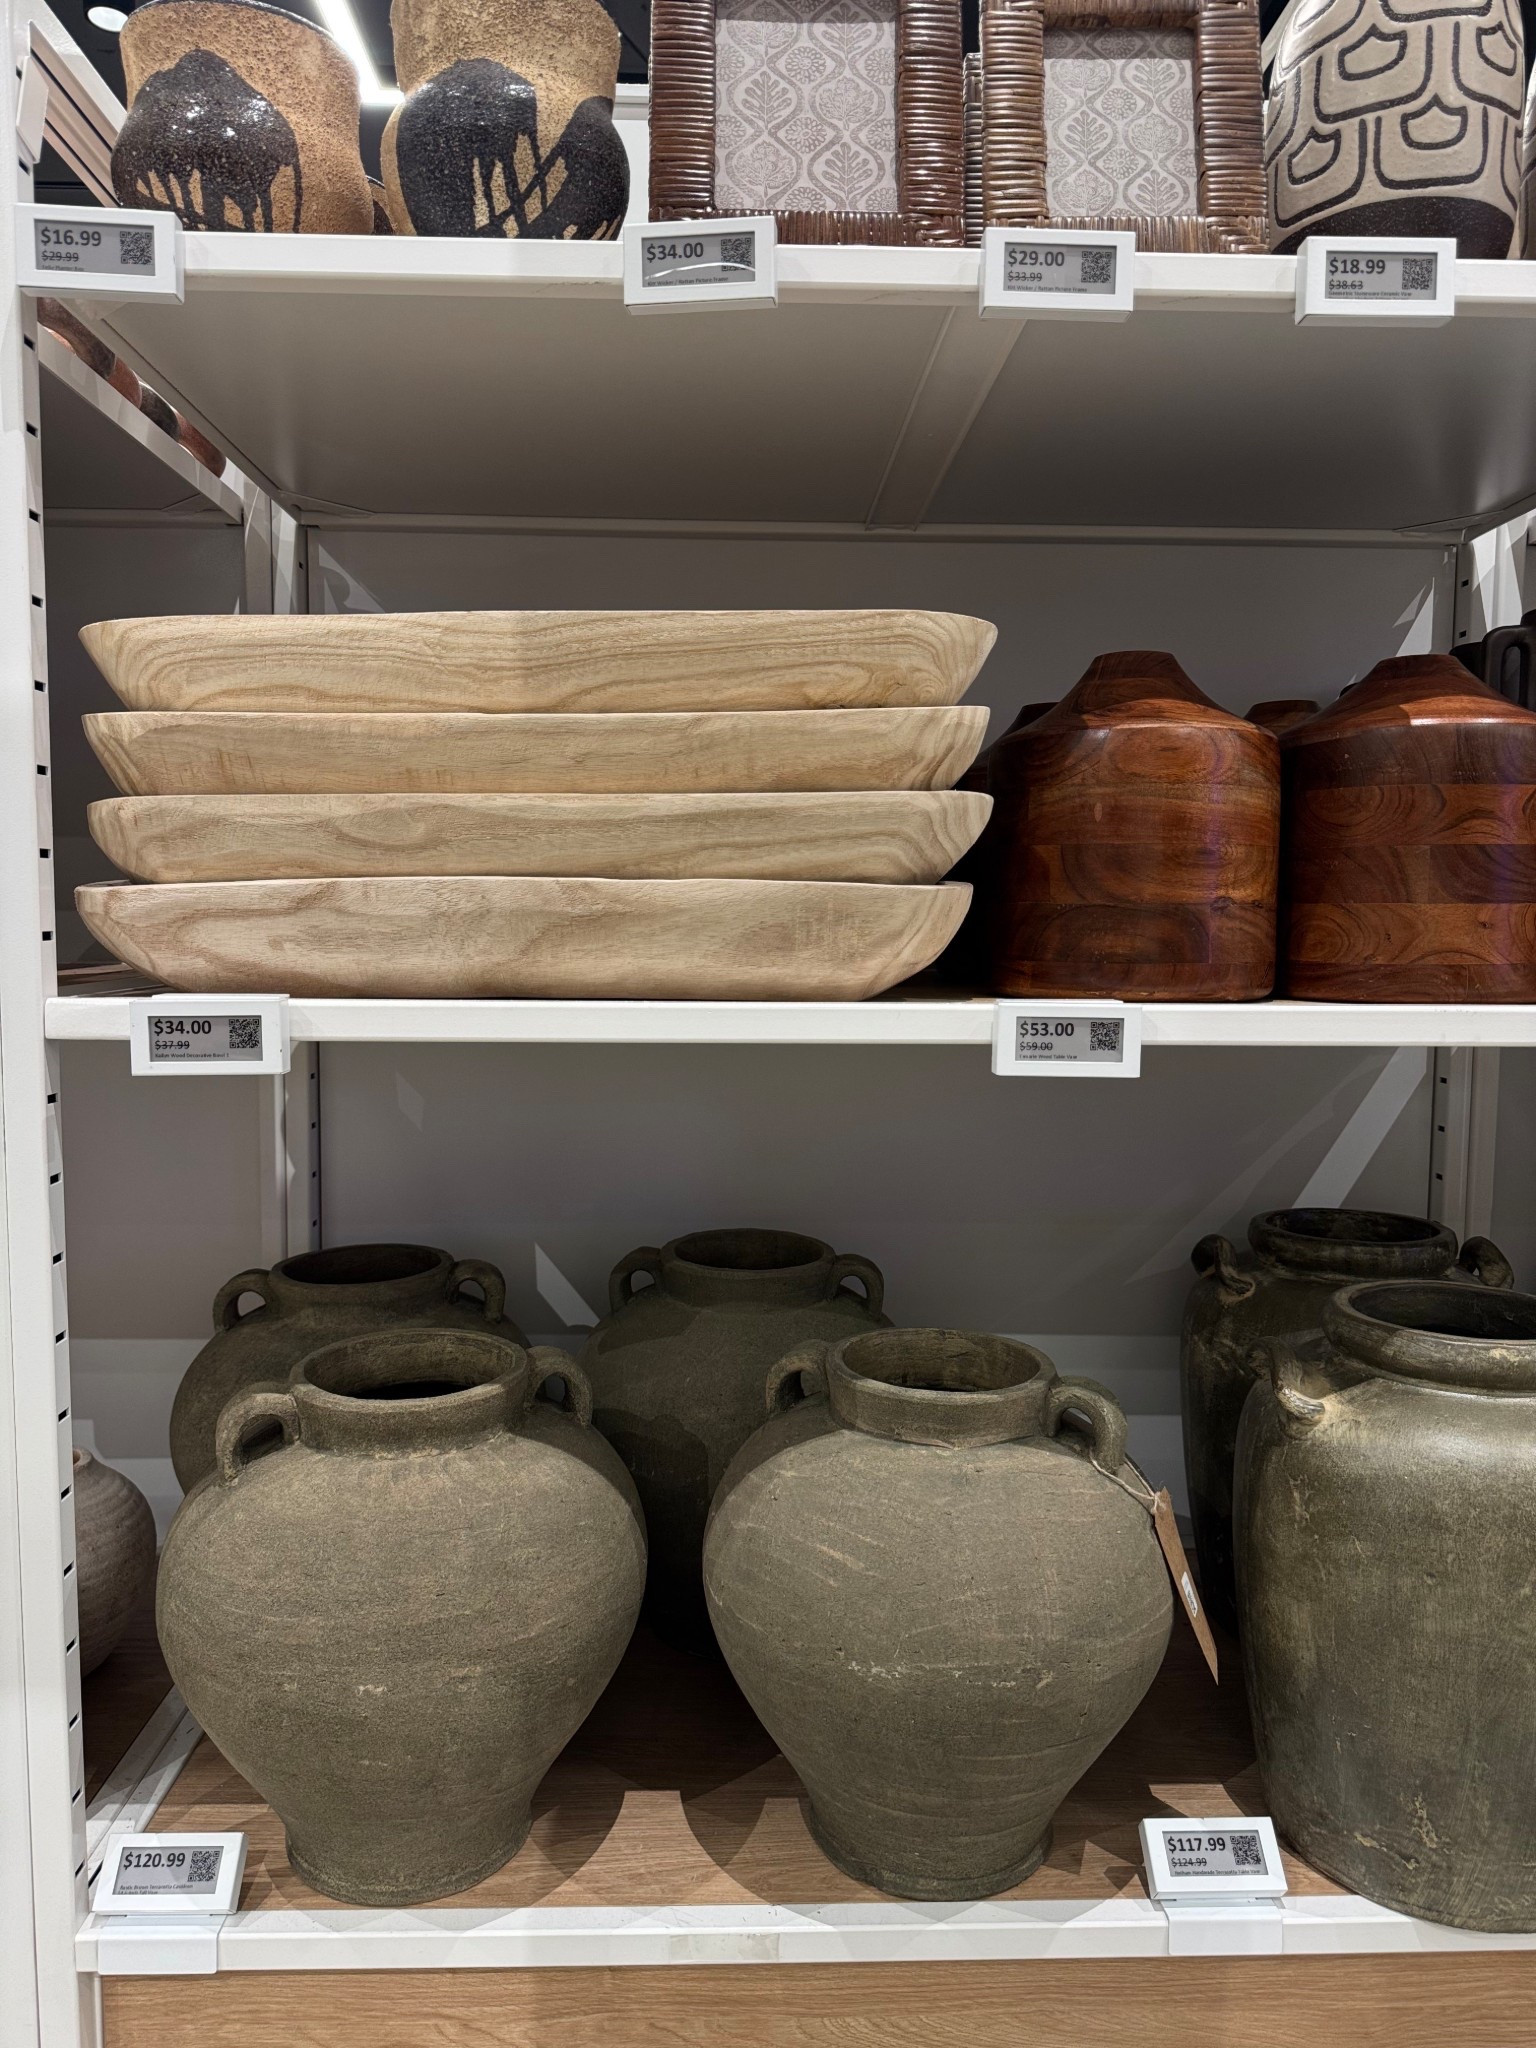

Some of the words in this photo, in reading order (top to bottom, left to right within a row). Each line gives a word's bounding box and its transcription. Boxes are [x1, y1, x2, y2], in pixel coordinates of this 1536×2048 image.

[41, 227, 101, 247] $16.99
[41, 250, 79, 262] $29.99
[646, 243, 704, 263] $34.00
[1008, 248, 1065, 268] $29.00
[1329, 257, 1386, 276] $18.99
[1008, 270, 1042, 282] $33.99
[1329, 279, 1363, 290] $38.63
[154, 1019, 212, 1037] $34.00
[1020, 1021, 1075, 1038] $53.00
[155, 1040, 190, 1051] $37.99
[1020, 1041, 1053, 1051] $59.00
[1168, 1836, 1226, 1854] $117.99
[123, 1851, 186, 1870] $120.99
[1171, 1857, 1207, 1868] $124.99
